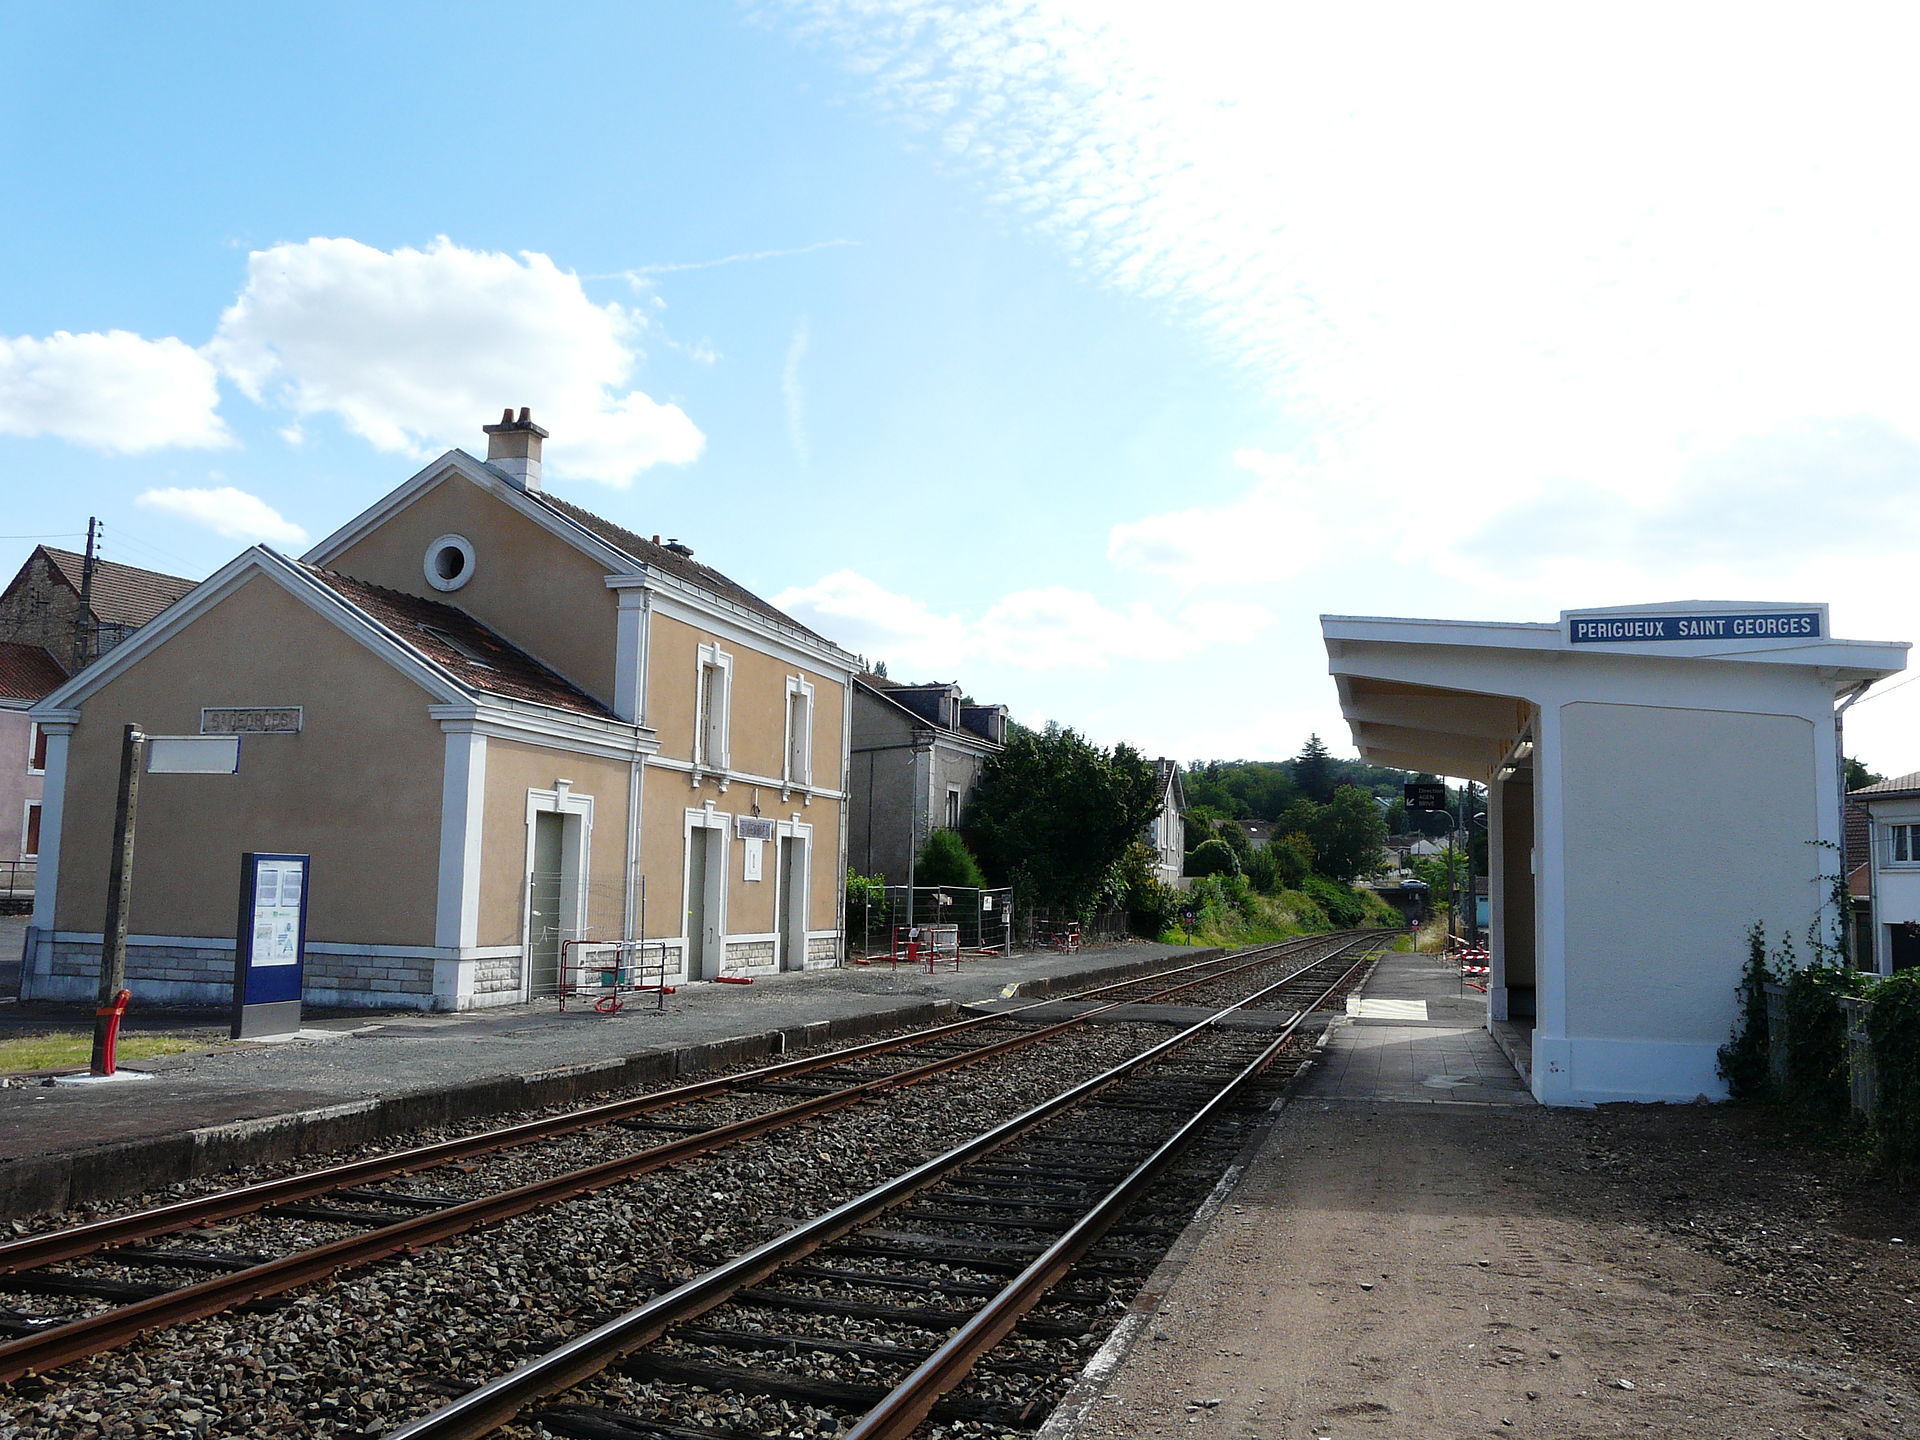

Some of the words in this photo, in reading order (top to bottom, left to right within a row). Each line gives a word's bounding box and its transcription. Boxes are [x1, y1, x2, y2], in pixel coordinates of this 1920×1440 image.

[1578, 622, 1664, 638] PERIGUEUX
[1679, 620, 1726, 636] SAINT
[1733, 617, 1811, 635] GEORGES
